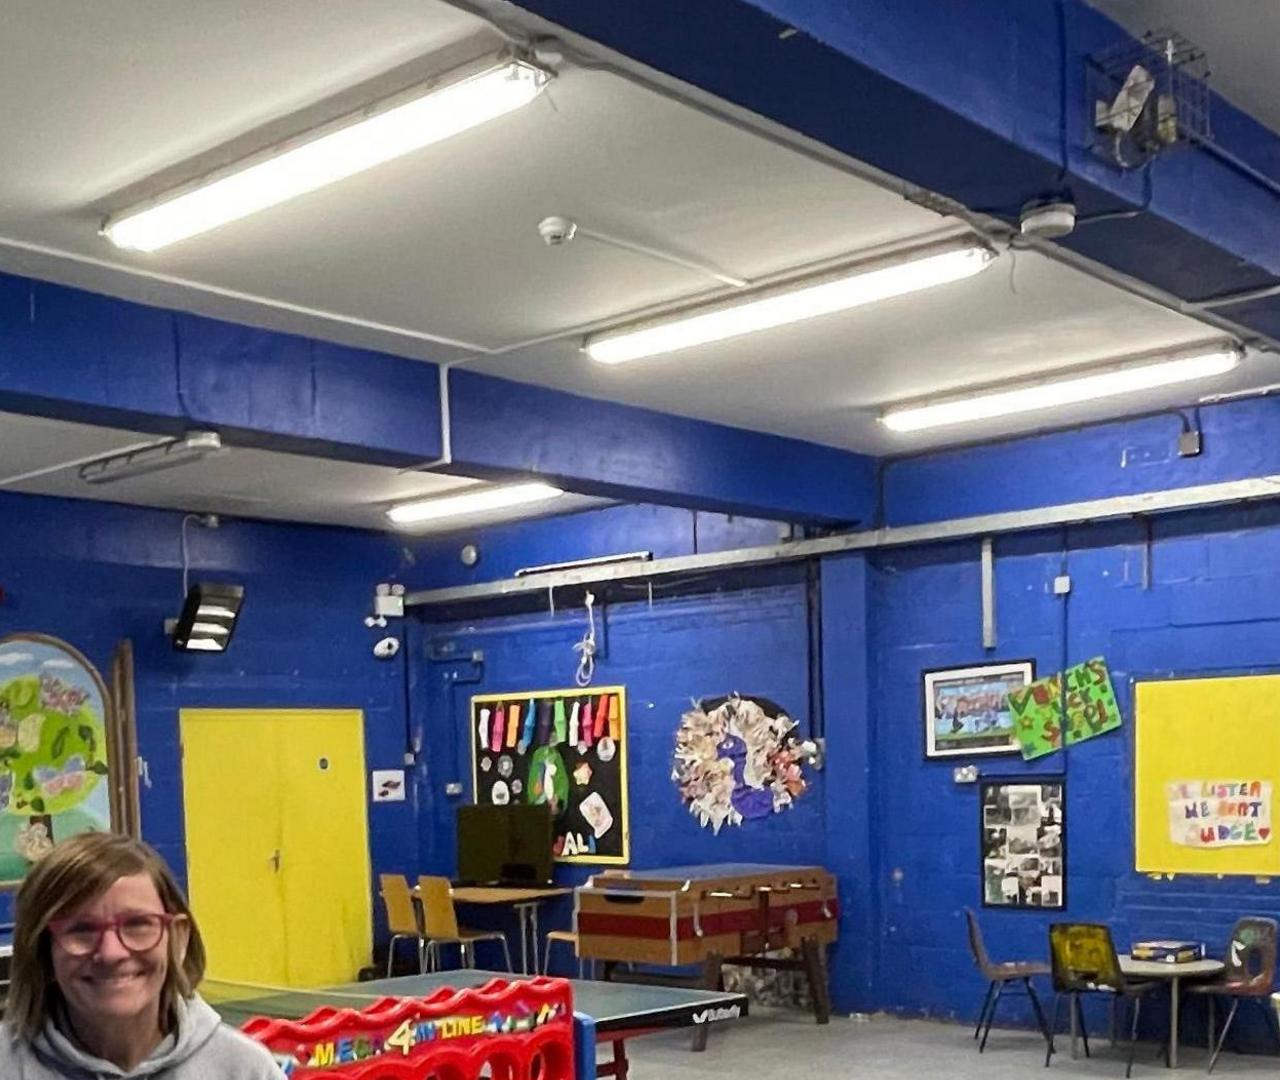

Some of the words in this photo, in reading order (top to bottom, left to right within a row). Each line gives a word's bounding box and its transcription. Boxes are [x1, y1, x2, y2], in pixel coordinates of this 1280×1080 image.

[1201, 781, 1261, 798] LISTEN
[1185, 801, 1210, 819] WE
[388, 1018, 412, 1055] 4
[441, 1015, 485, 1038] LINE
